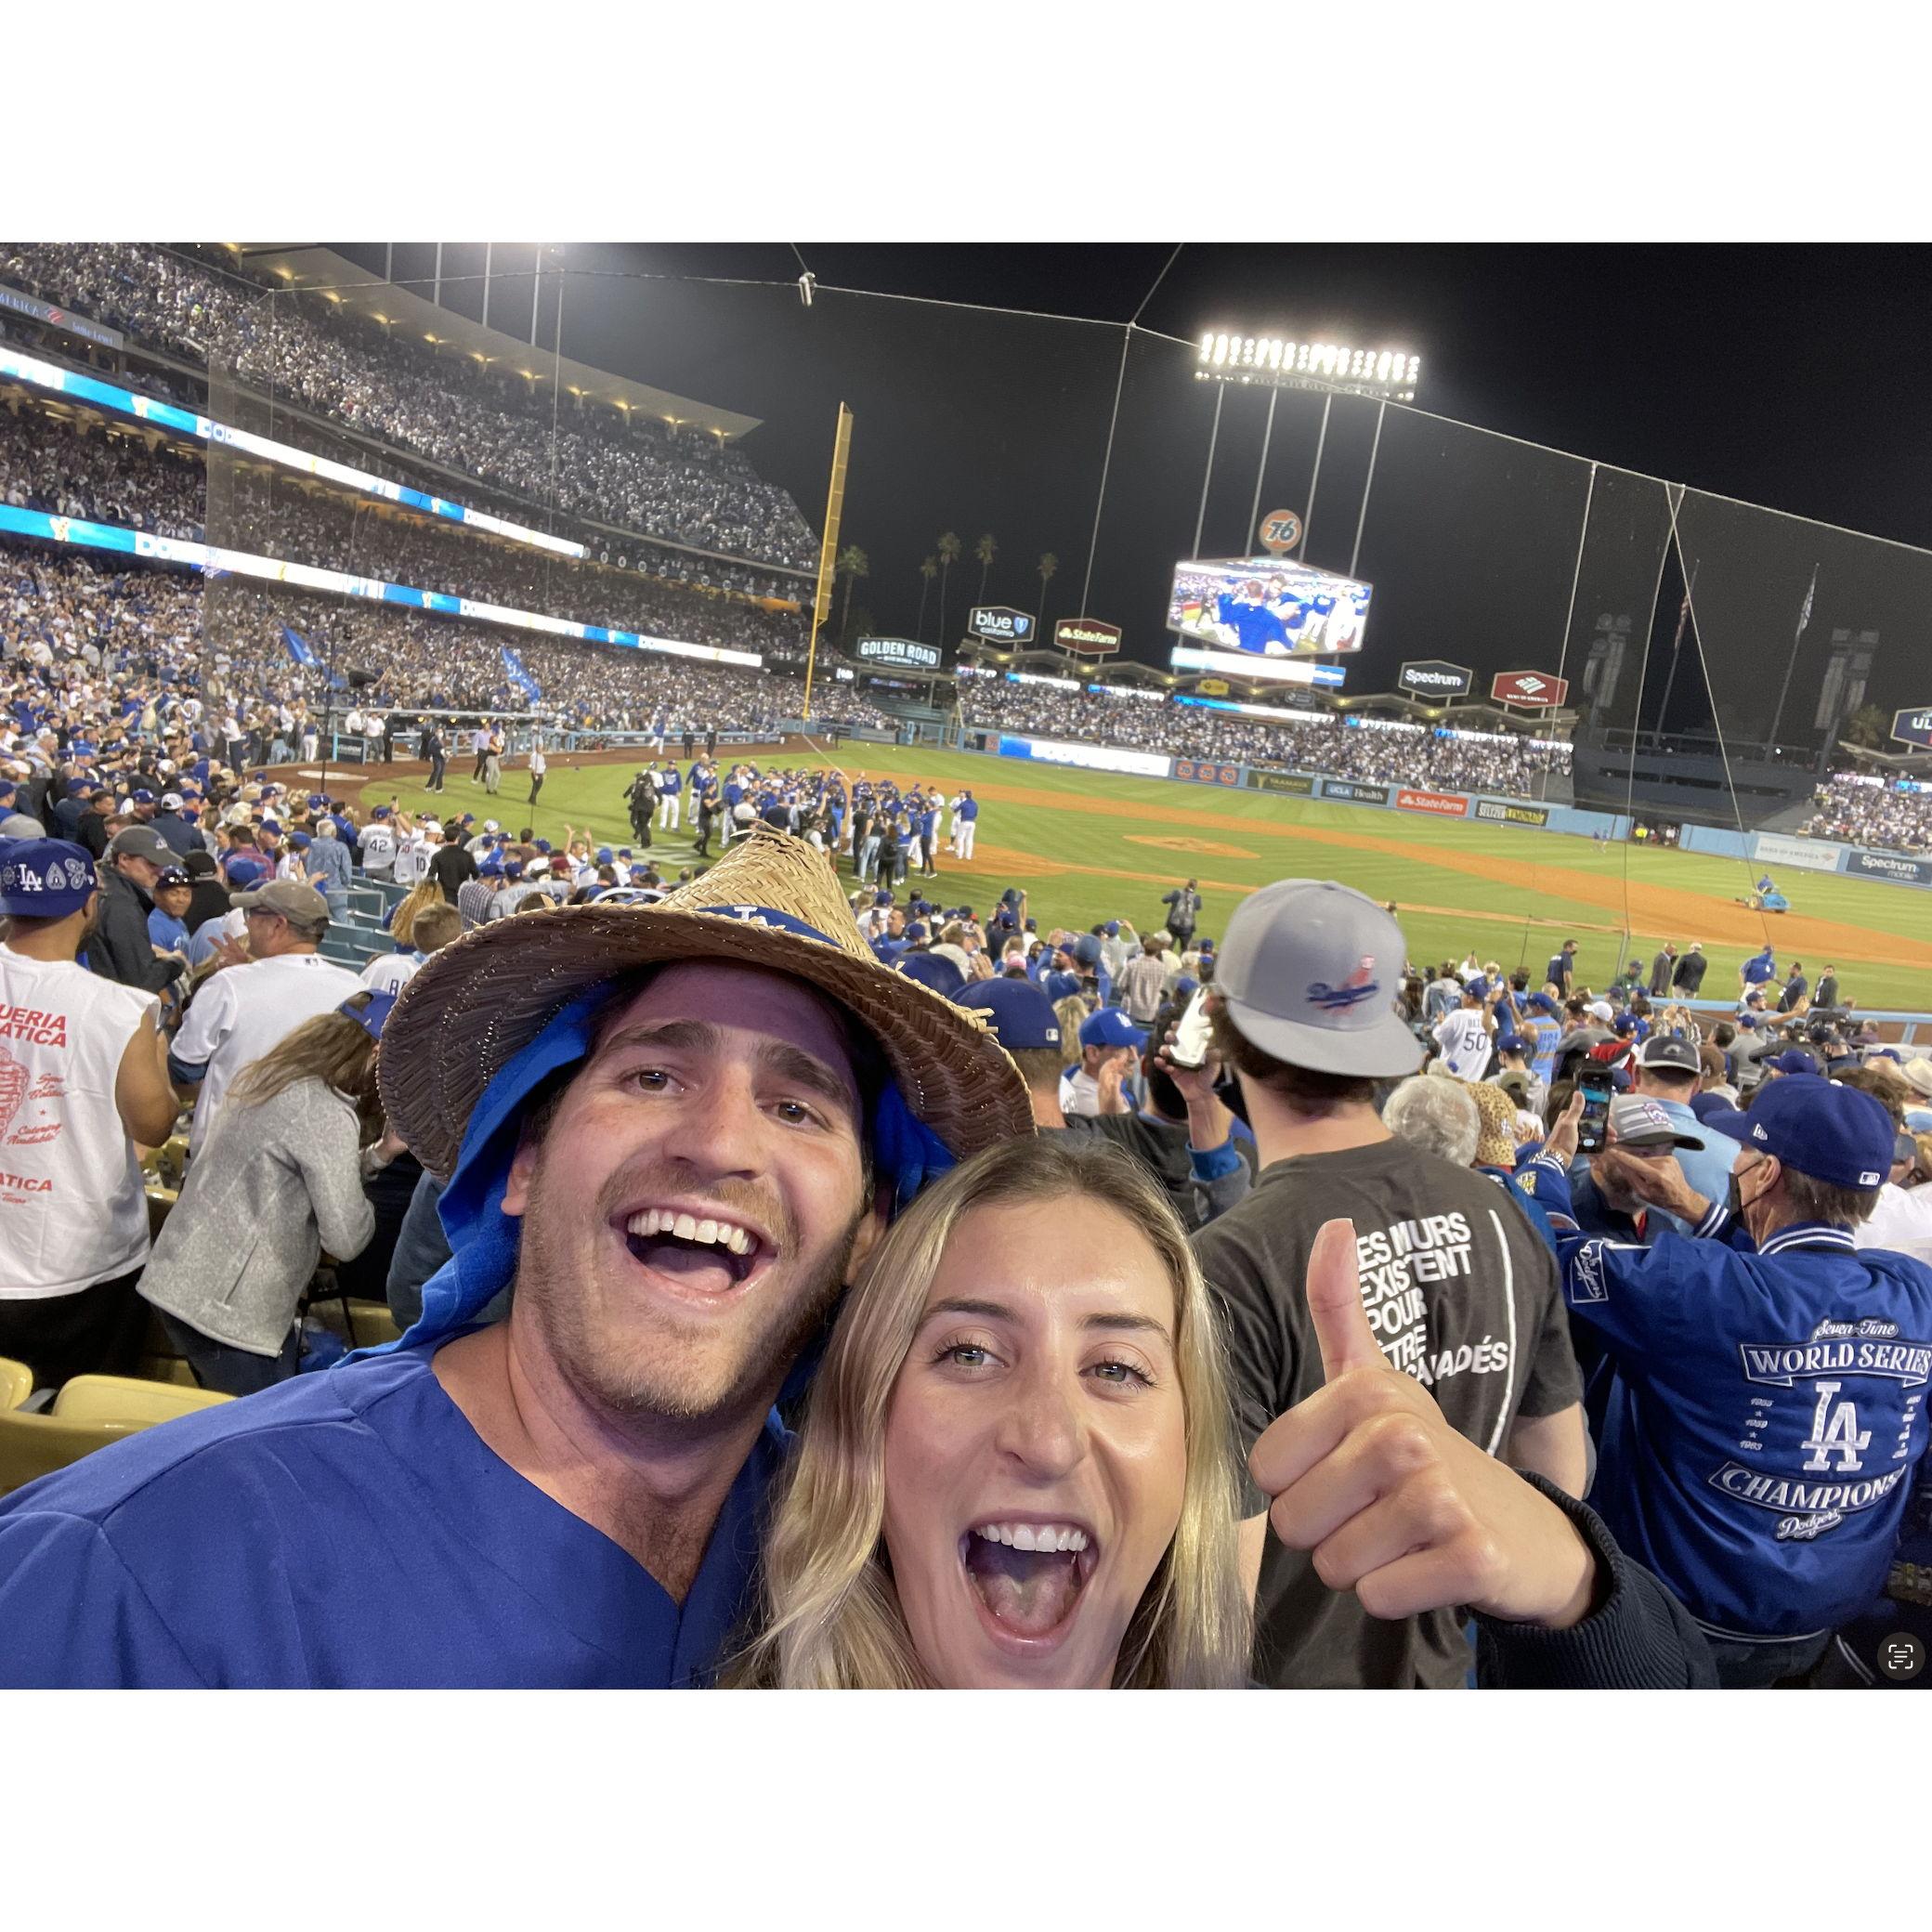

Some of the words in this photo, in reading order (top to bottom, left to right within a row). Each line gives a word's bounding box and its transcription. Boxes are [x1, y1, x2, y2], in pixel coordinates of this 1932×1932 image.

[1265, 518, 1297, 543] 76
[976, 610, 1012, 630] blue
[861, 641, 906, 656] GOLDEN
[907, 645, 937, 665] ROAD
[1405, 669, 1461, 686] Spectrum
[1329, 786, 1350, 796] UCLA
[1354, 788, 1383, 801] Health
[370, 838, 388, 853] 42
[416, 855, 426, 872] 10
[1862, 855, 1917, 873] Spectrum
[19, 863, 43, 892] LA
[1463, 1032, 1487, 1051] 50
[1356, 1231, 1392, 1273] ES
[1389, 1212, 1471, 1258] MURS
[1365, 1286, 1429, 1335] POUR
[1814, 1317, 1898, 1340] Seven-Time
[1377, 1325, 1428, 1370] TRE
[1748, 1345, 1856, 1375] WORLD
[1858, 1343, 1932, 1376] SERIES
[1800, 1381, 1873, 1472] LA
[1721, 1469, 1899, 1509] CHAMPIONS
[1776, 1508, 1843, 1539] Dodgers
